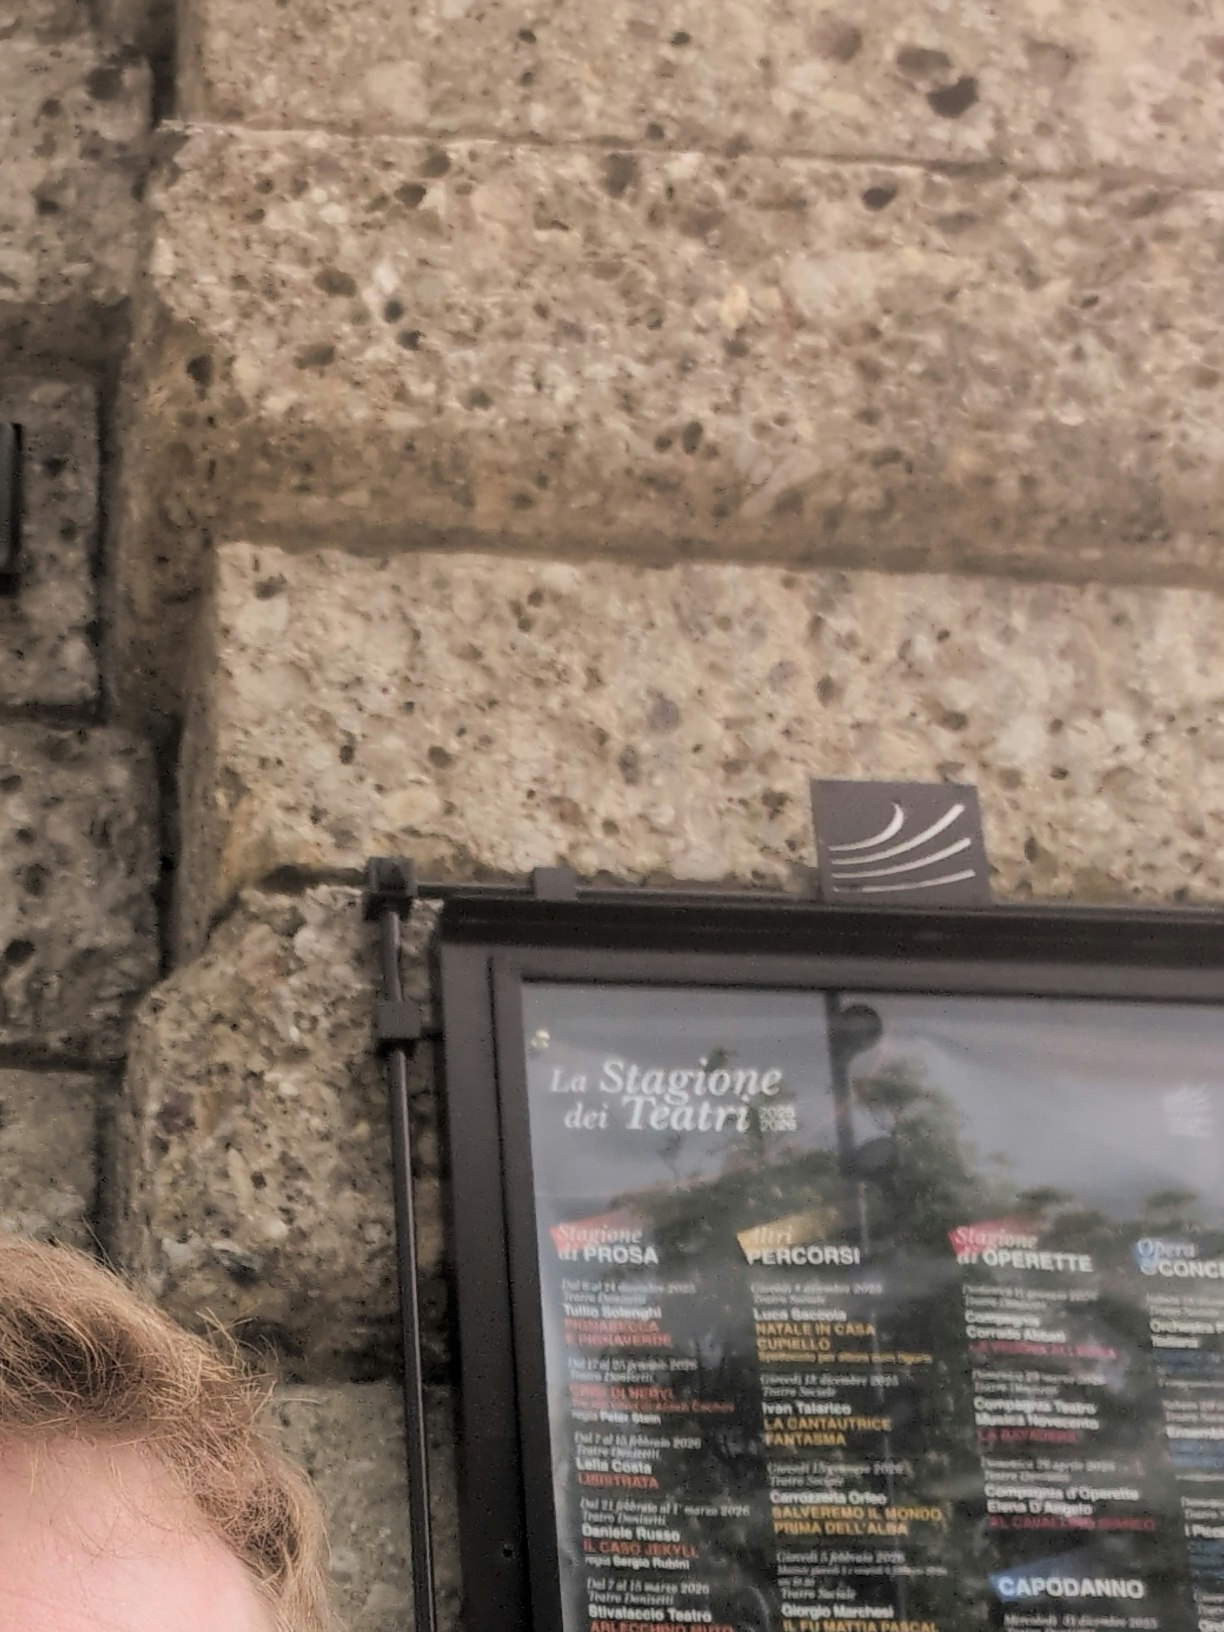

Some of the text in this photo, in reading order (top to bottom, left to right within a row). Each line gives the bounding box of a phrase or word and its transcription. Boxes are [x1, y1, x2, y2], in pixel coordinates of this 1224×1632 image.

[549, 1057, 783, 1106] La Stagione
[564, 1094, 750, 1132] dei Teatri
[557, 1224, 643, 1246] Stagione
[956, 1226, 1038, 1249] Stagione
[584, 1246, 658, 1265] PROSA
[747, 1246, 861, 1265] PERCORSI
[982, 1249, 1094, 1272] OPERETTE
[1159, 1260, 1224, 1278] CONC
[753, 1308, 788, 1320] Luca
[756, 1322, 875, 1336] NATALE IN CASA
[756, 1337, 831, 1350] CUPIELLO
[762, 1401, 851, 1415] Ivan Talarico
[764, 1417, 892, 1431] LA CANTAUTRICE
[766, 1432, 846, 1446] FANTASMA
[576, 1458, 652, 1474] Lella Costa
[578, 1472, 659, 1488] LISISTRATA
[849, 1490, 887, 1504] Orfeo
[721, 1505, 750, 1517] 2026
[772, 1505, 942, 1520] SALVEREMO IL MONDO
[582, 1524, 680, 1542] Daniele Russo
[774, 1521, 908, 1536] PRIMA DELL'ALBA
[582, 1540, 699, 1559] IL CASO JEKYLL
[613, 1556, 690, 1570] Sergio Rubini
[998, 1577, 1145, 1599] CAPODANNO
[589, 1605, 712, 1622] Stivalaccio Teatro
[781, 1603, 894, 1620] Giorgio Marchesi
[783, 1620, 796, 1632] IL
[800, 1620, 820, 1632] FU
